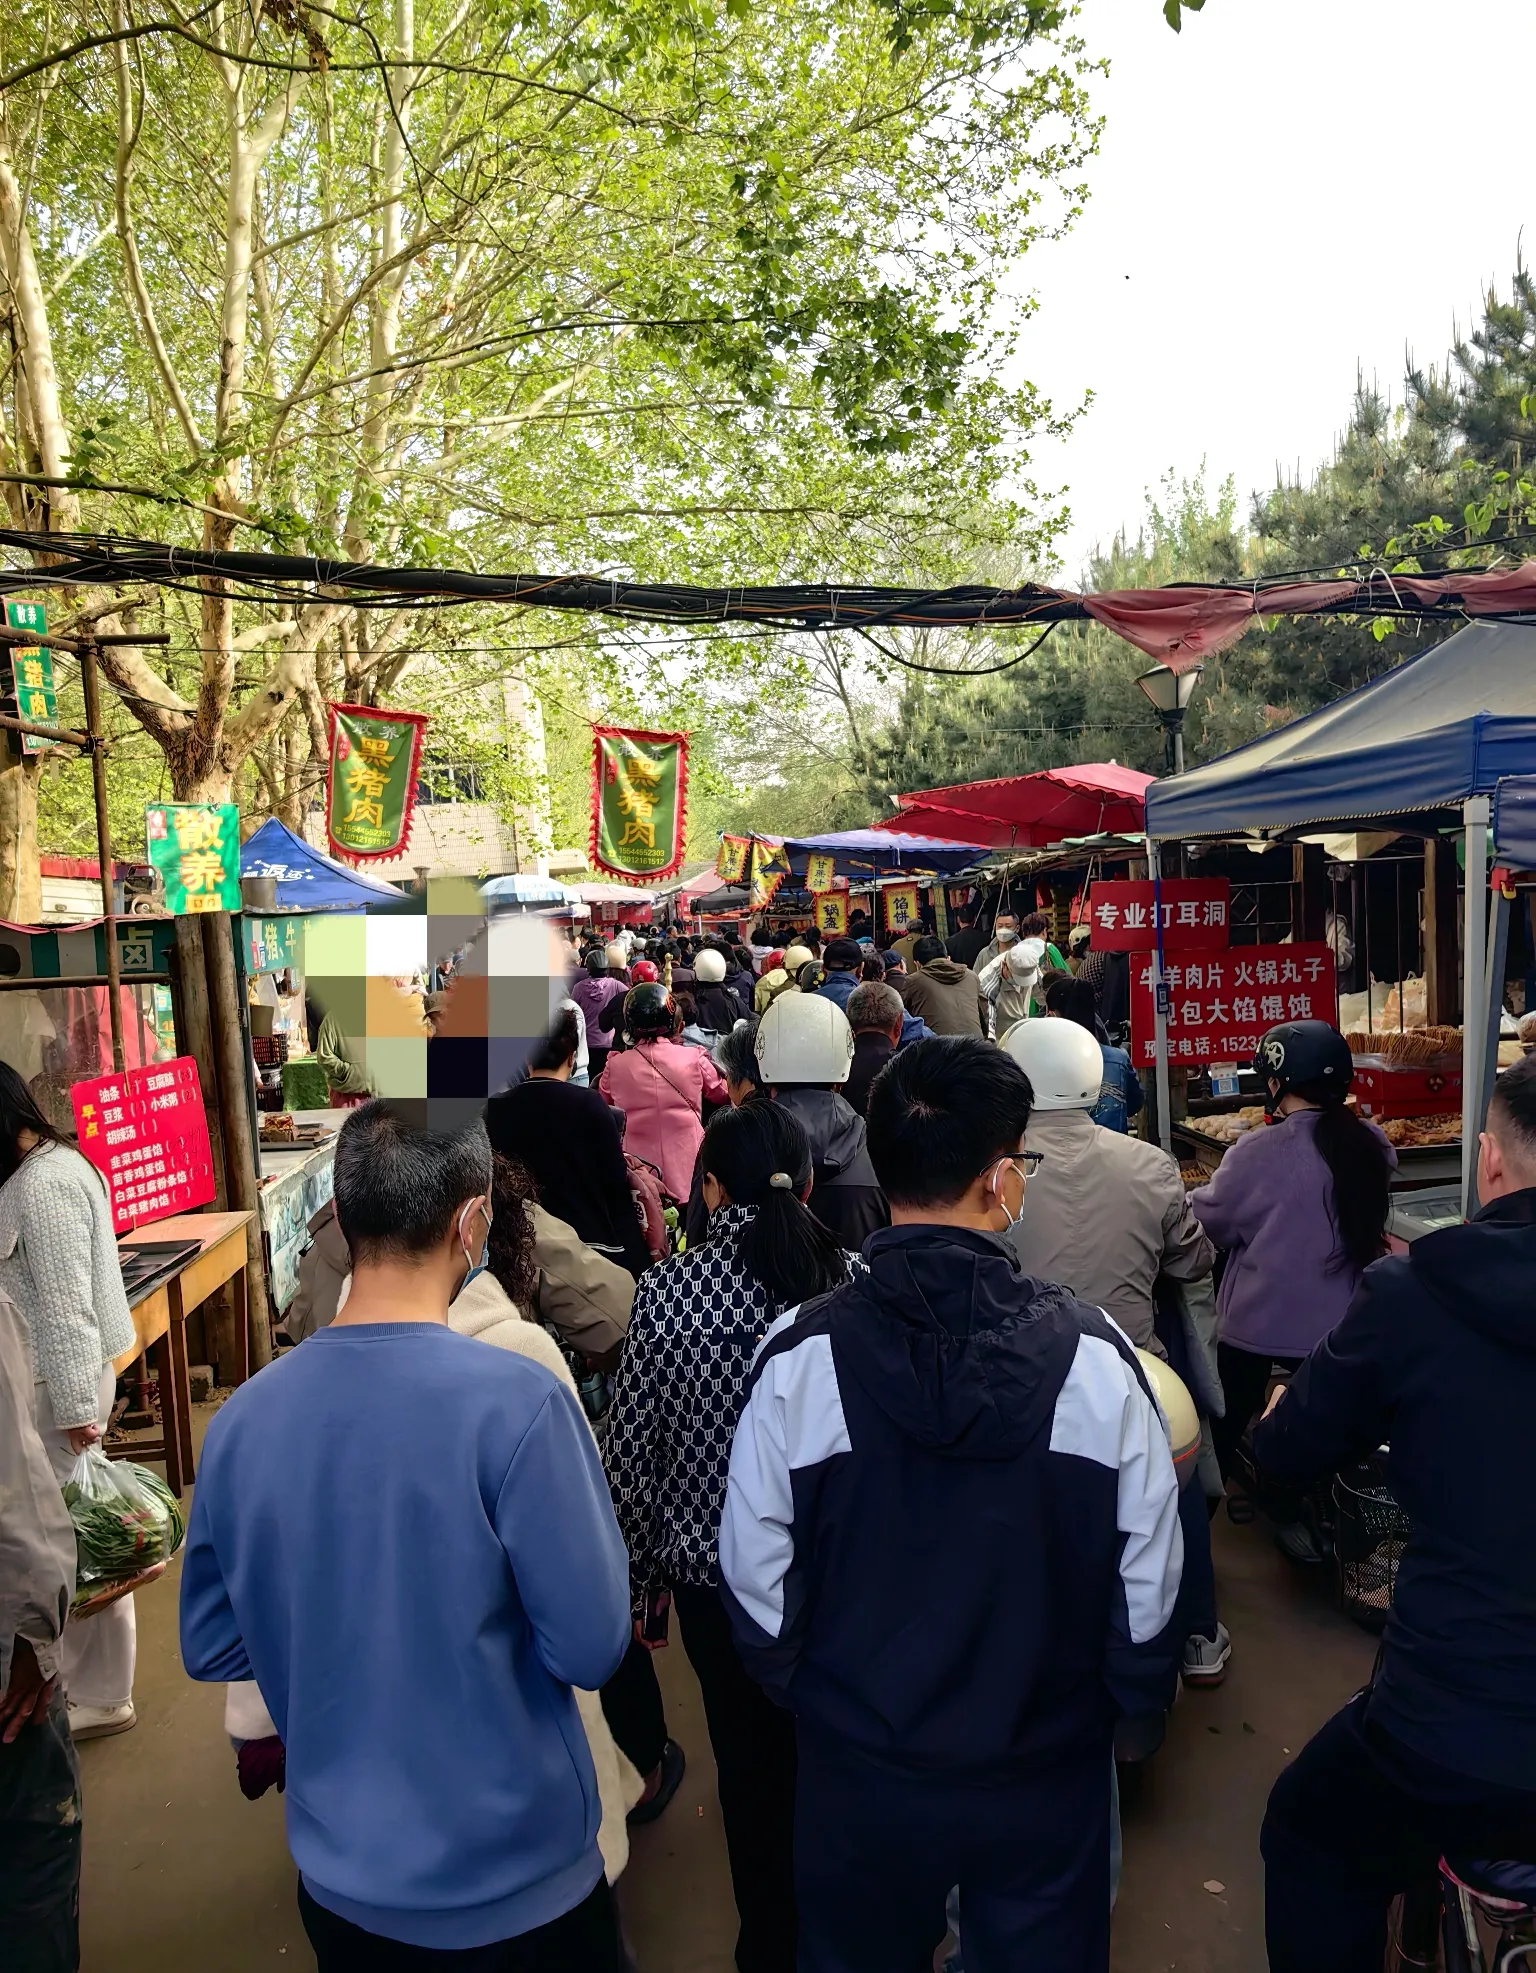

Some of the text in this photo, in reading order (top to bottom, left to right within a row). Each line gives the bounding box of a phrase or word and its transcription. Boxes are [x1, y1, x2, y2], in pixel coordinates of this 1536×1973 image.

[16, 605, 37, 624] 散养
[352, 721, 399, 740] 散养
[343, 737, 396, 828] 黑猪肉
[617, 759, 661, 848] 黑猪肉
[723, 848, 740, 875] 甘蔗汁
[814, 860, 828, 888] 甘蔗汁
[893, 897, 909, 924] 馅饼
[1095, 900, 1226, 931] 专业打耳洞
[117, 927, 154, 972] 卤
[1139, 957, 1326, 993] 牛羊肉片 火锅丸子
[99, 1086, 120, 1104] 油条
[102, 1107, 124, 1125] 豆浆
[150, 1092, 179, 1112] 小米粥
[81, 1104, 99, 1139] 早点
[106, 1125, 136, 1145] 胡辣汤
[110, 1143, 163, 1170] 韭菜鸡蛋馅
[112, 1160, 165, 1187] 茴香鸡蛋馅
[115, 1170, 187, 1203] 白菜豆腐粉条馅
[117, 1193, 170, 1221] 白菜猪肉馅
